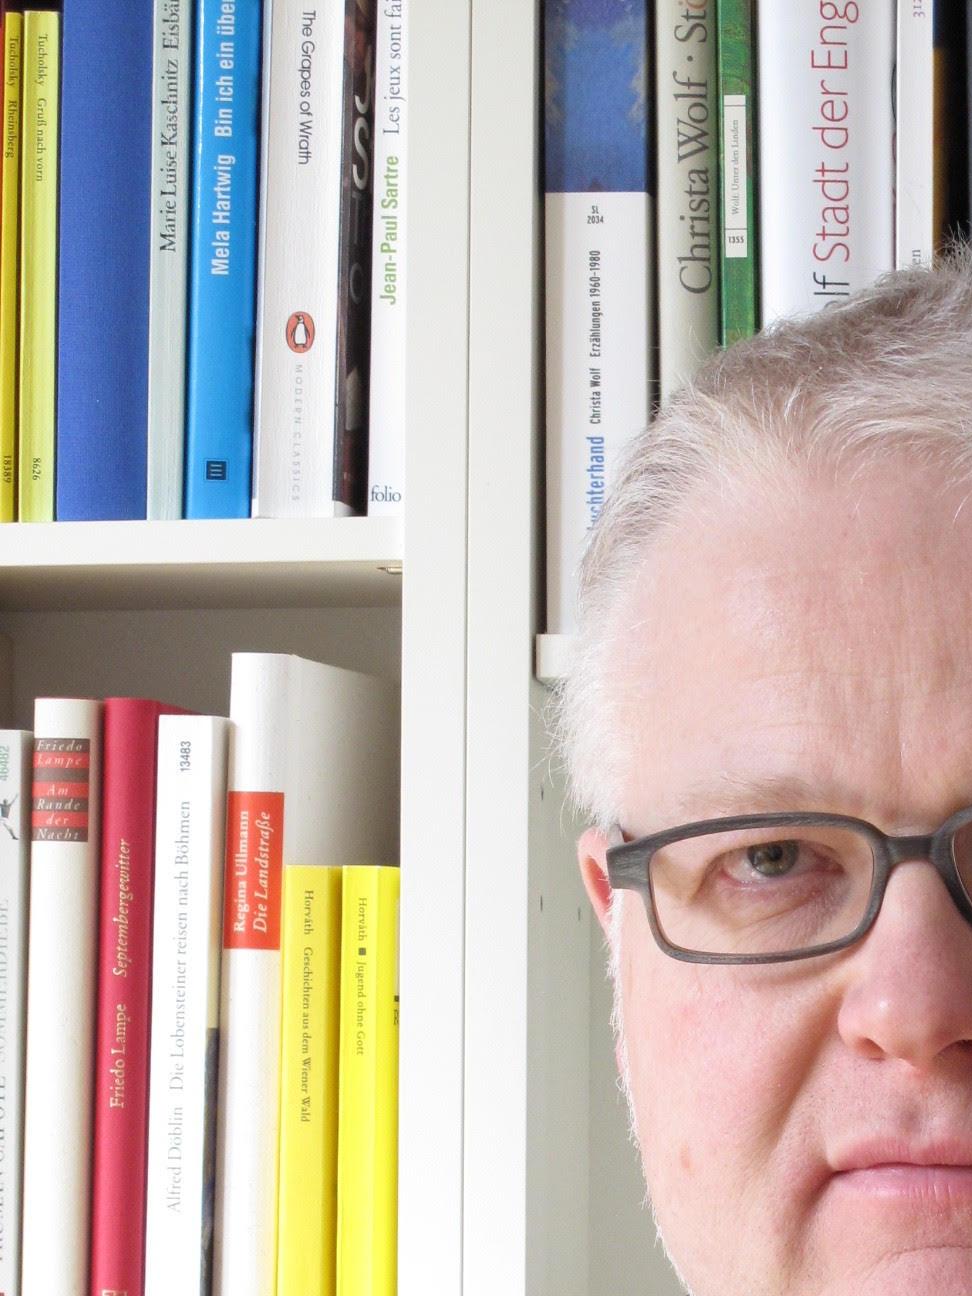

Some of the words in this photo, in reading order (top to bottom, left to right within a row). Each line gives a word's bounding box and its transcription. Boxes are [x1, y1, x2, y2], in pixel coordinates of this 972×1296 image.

[301, 10, 316, 37] The
[387, 25, 402, 60] sont
[811, 0, 859, 70] Eng
[7, 37, 19, 87] Tucholsky
[34, 34, 48, 87] Tucholsky
[216, 42, 235, 69] ein
[298, 41, 315, 97] Grapes
[160, 59, 180, 146] Kaschnitz
[215, 76, 234, 101] ich
[384, 66, 406, 102] jeux
[214, 108, 233, 137] Bin
[299, 101, 312, 117] of
[383, 107, 400, 135] Les
[671, 70, 709, 163] Wolf
[811, 80, 849, 149] der
[5, 100, 18, 159] Rheinsberg
[36, 130, 47, 154] nach
[298, 120, 313, 165] Wrath
[730, 119, 740, 148] Linden
[36, 157, 45, 182] vorn
[160, 151, 178, 196] Luise
[730, 150, 740, 163] den
[211, 154, 236, 224] Hartwig
[381, 156, 399, 209] Sartre
[159, 201, 178, 253] Marie
[587, 215, 604, 225] 2034
[676, 167, 712, 295] Christa
[812, 161, 850, 263] Stadt
[210, 230, 230, 276] Mela
[378, 216, 399, 306] Jean-Paul
[588, 250, 602, 298] 1960-1980
[588, 301, 604, 357] Erzählungen
[294, 364, 304, 425] MODERN
[588, 368, 602, 388] Wolf
[589, 391, 602, 424] Christa
[3, 455, 12, 484] 18389
[32, 458, 41, 481] 8626
[291, 432, 303, 502] CLASSICS
[371, 484, 402, 502] folio
[36, 739, 83, 752] Friedo
[36, 753, 83, 769] Lampe
[179, 740, 192, 773] 13483
[36, 798, 81, 811] Rande
[46, 783, 70, 796] Am
[36, 828, 79, 841] Nacht
[46, 813, 70, 826] der
[174, 800, 191, 866] Böhmen
[232, 810, 250, 877] Ullmann
[252, 811, 271, 900] Landstraße
[173, 870, 189, 907] nach
[233, 881, 251, 934] Regina
[112, 838, 134, 978] Septembergewitter
[252, 903, 268, 934] Die
[302, 889, 315, 936] Horváth
[357, 897, 369, 942] Horváth
[173, 912, 189, 955] reisen
[301, 946, 314, 1010] Geschichten
[355, 961, 368, 999] Jugend
[169, 960, 187, 1058] Lobensteiner
[301, 1012, 311, 1030] aus
[356, 1001, 368, 1028] ohne
[111, 1003, 130, 1055] Lampe
[301, 1031, 313, 1055] dem
[356, 1031, 367, 1056] Gott
[109, 1058, 126, 1108] Friedo
[169, 1063, 185, 1091] Die
[300, 1056, 313, 1094] Wiener
[300, 1096, 312, 1123] Wald
[166, 1166, 183, 1214] Alfred
